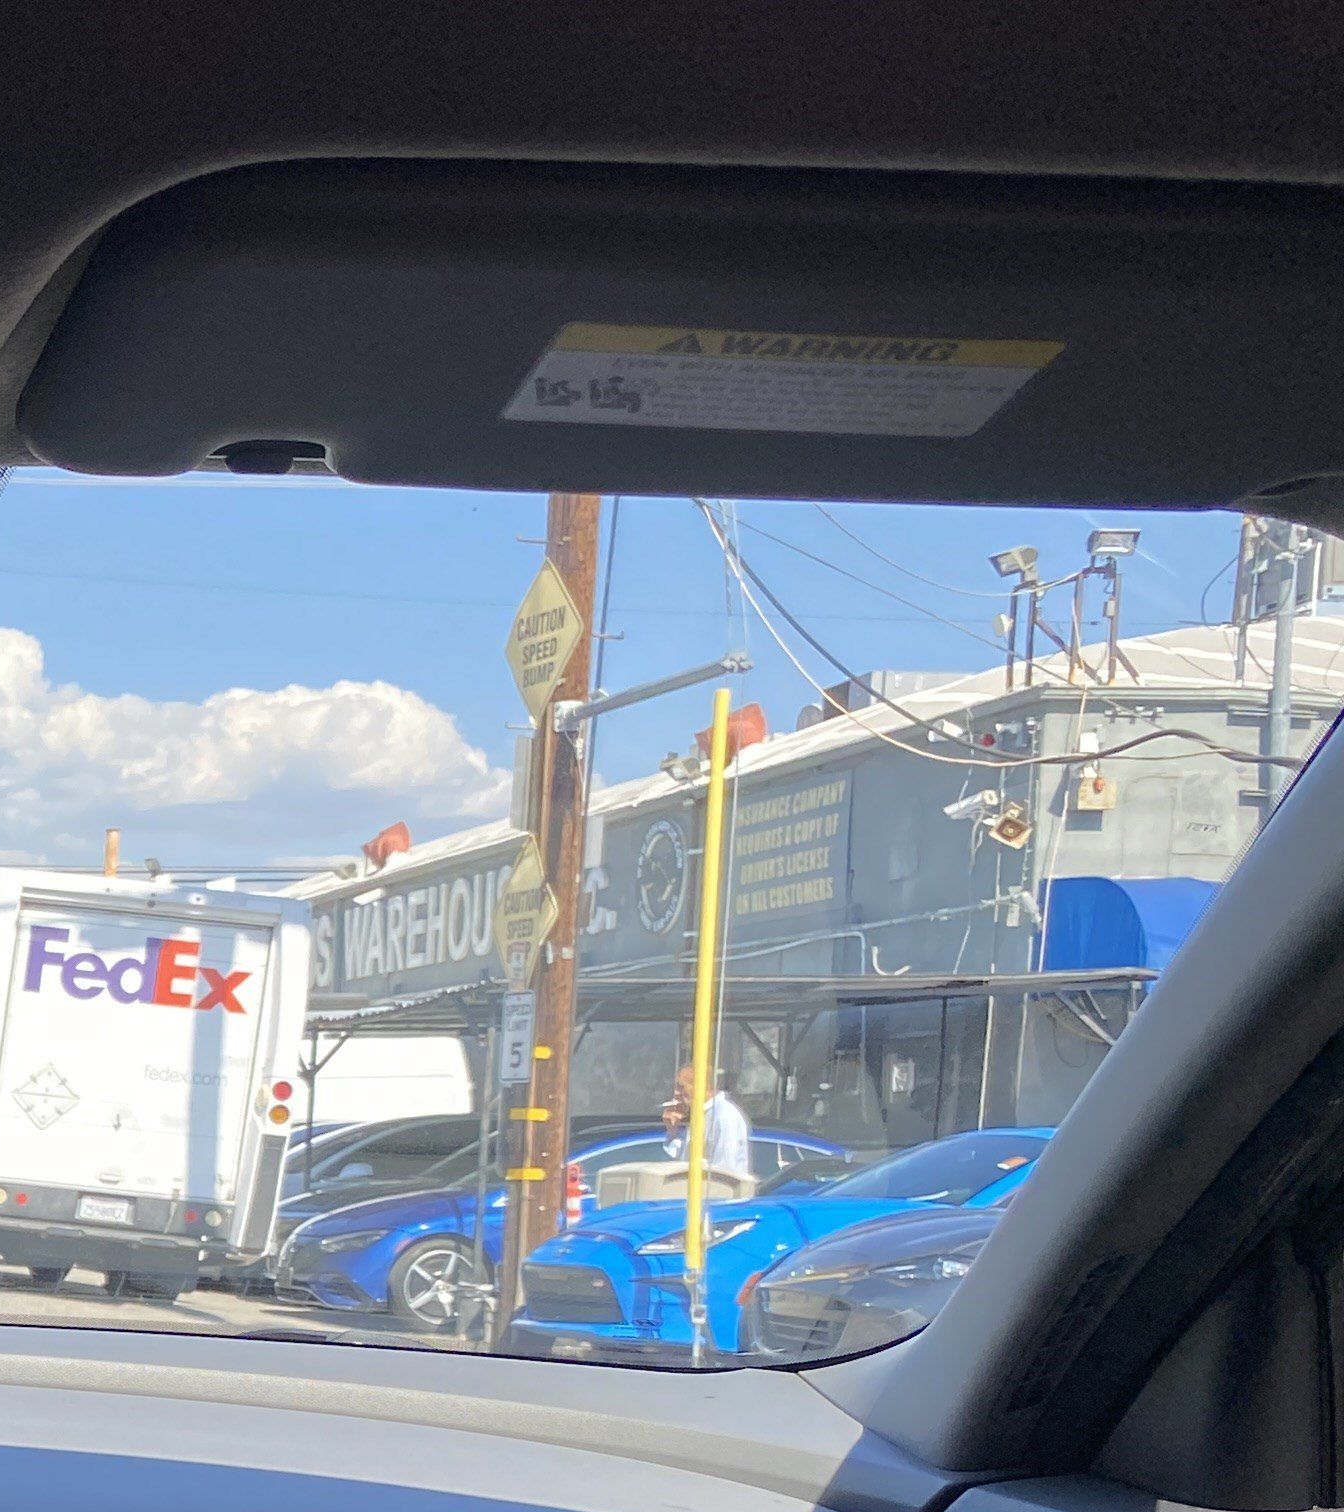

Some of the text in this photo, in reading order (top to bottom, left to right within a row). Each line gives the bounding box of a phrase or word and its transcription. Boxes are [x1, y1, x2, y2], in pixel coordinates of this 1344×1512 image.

[722, 333, 958, 362] WARNING
[517, 605, 566, 641] CAUTION
[522, 638, 557, 665] SPEED
[523, 661, 555, 689] BUMP
[793, 780, 846, 814] COMPANY
[795, 817, 823, 844] COPY
[825, 813, 839, 837] OF
[787, 847, 830, 875] LICENSE
[23, 925, 253, 1015] FedEx
[144, 1064, 229, 1088] fedex.com
